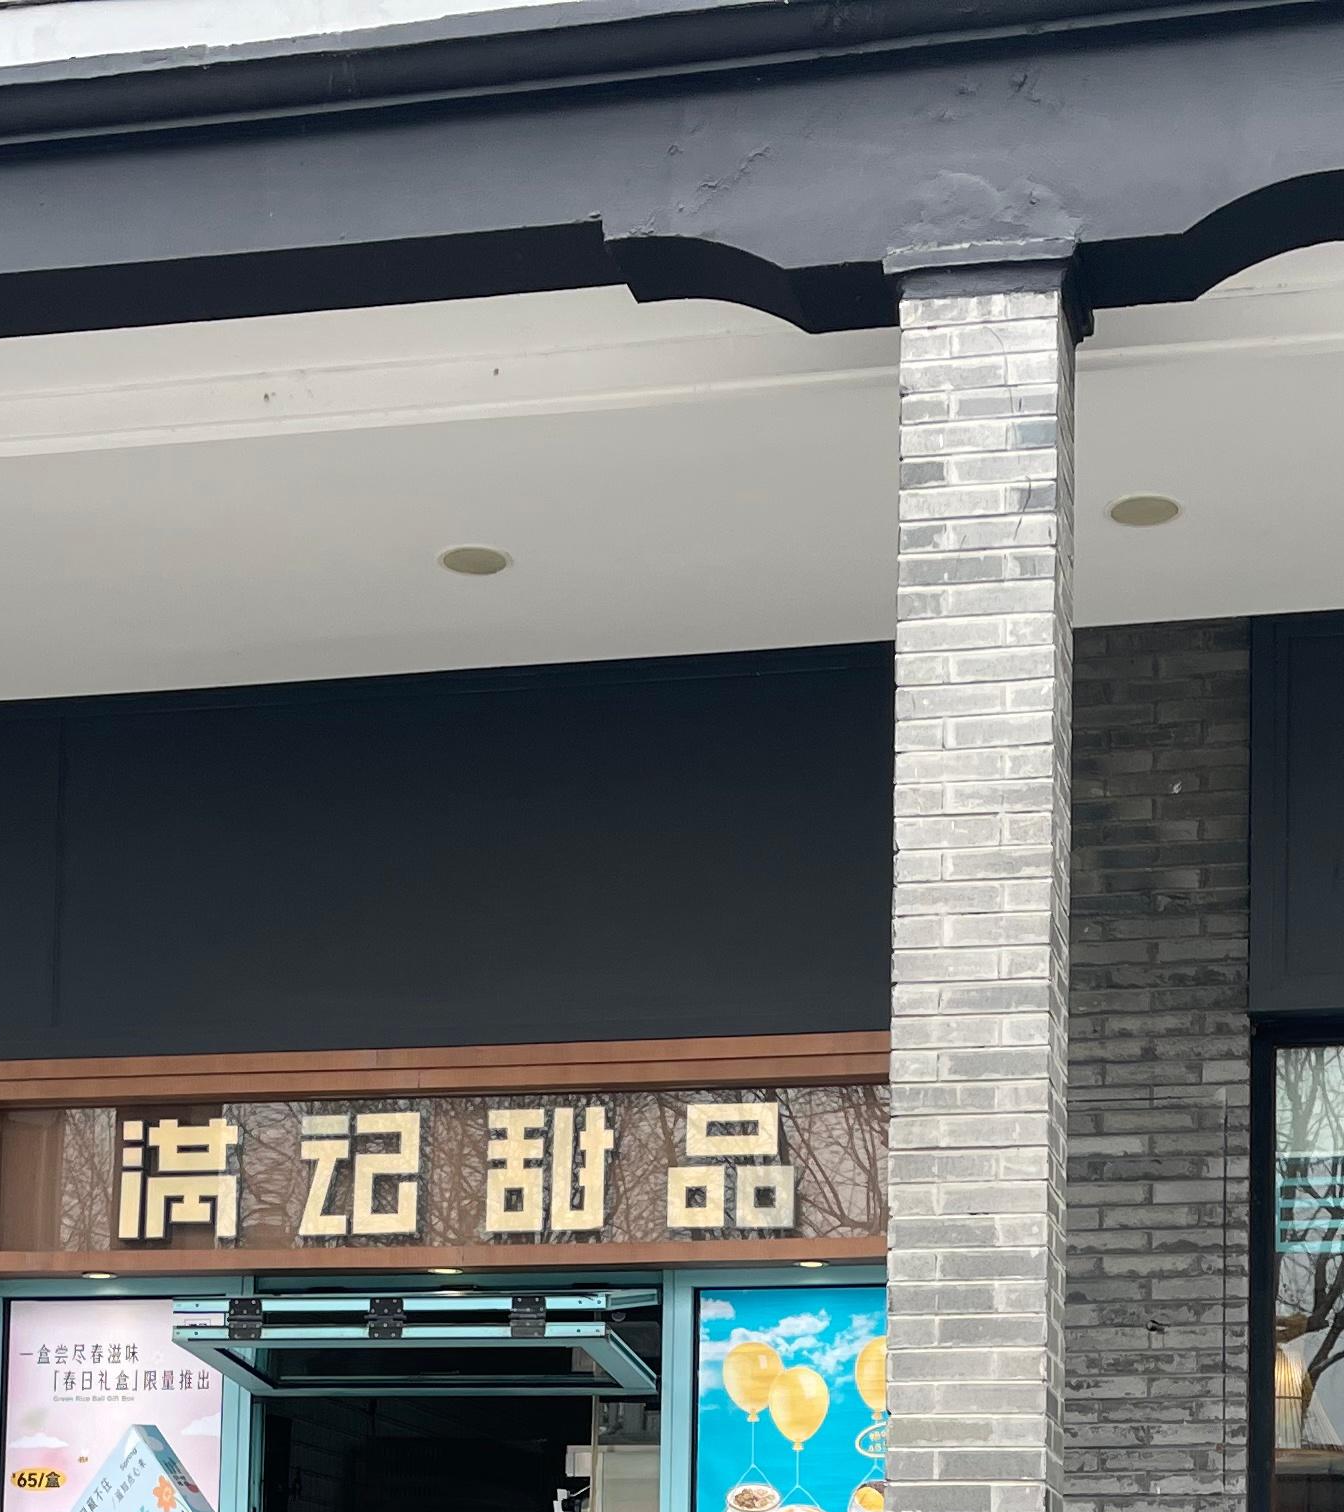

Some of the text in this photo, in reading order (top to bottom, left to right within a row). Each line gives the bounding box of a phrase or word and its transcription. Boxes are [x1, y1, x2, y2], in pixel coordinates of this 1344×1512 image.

[117, 1102, 794, 1239] 满记甜品
[19, 1343, 140, 1365] 一盒尝尽春滋味
[53, 1369, 210, 1391] 「春日礼盒」限量推出
